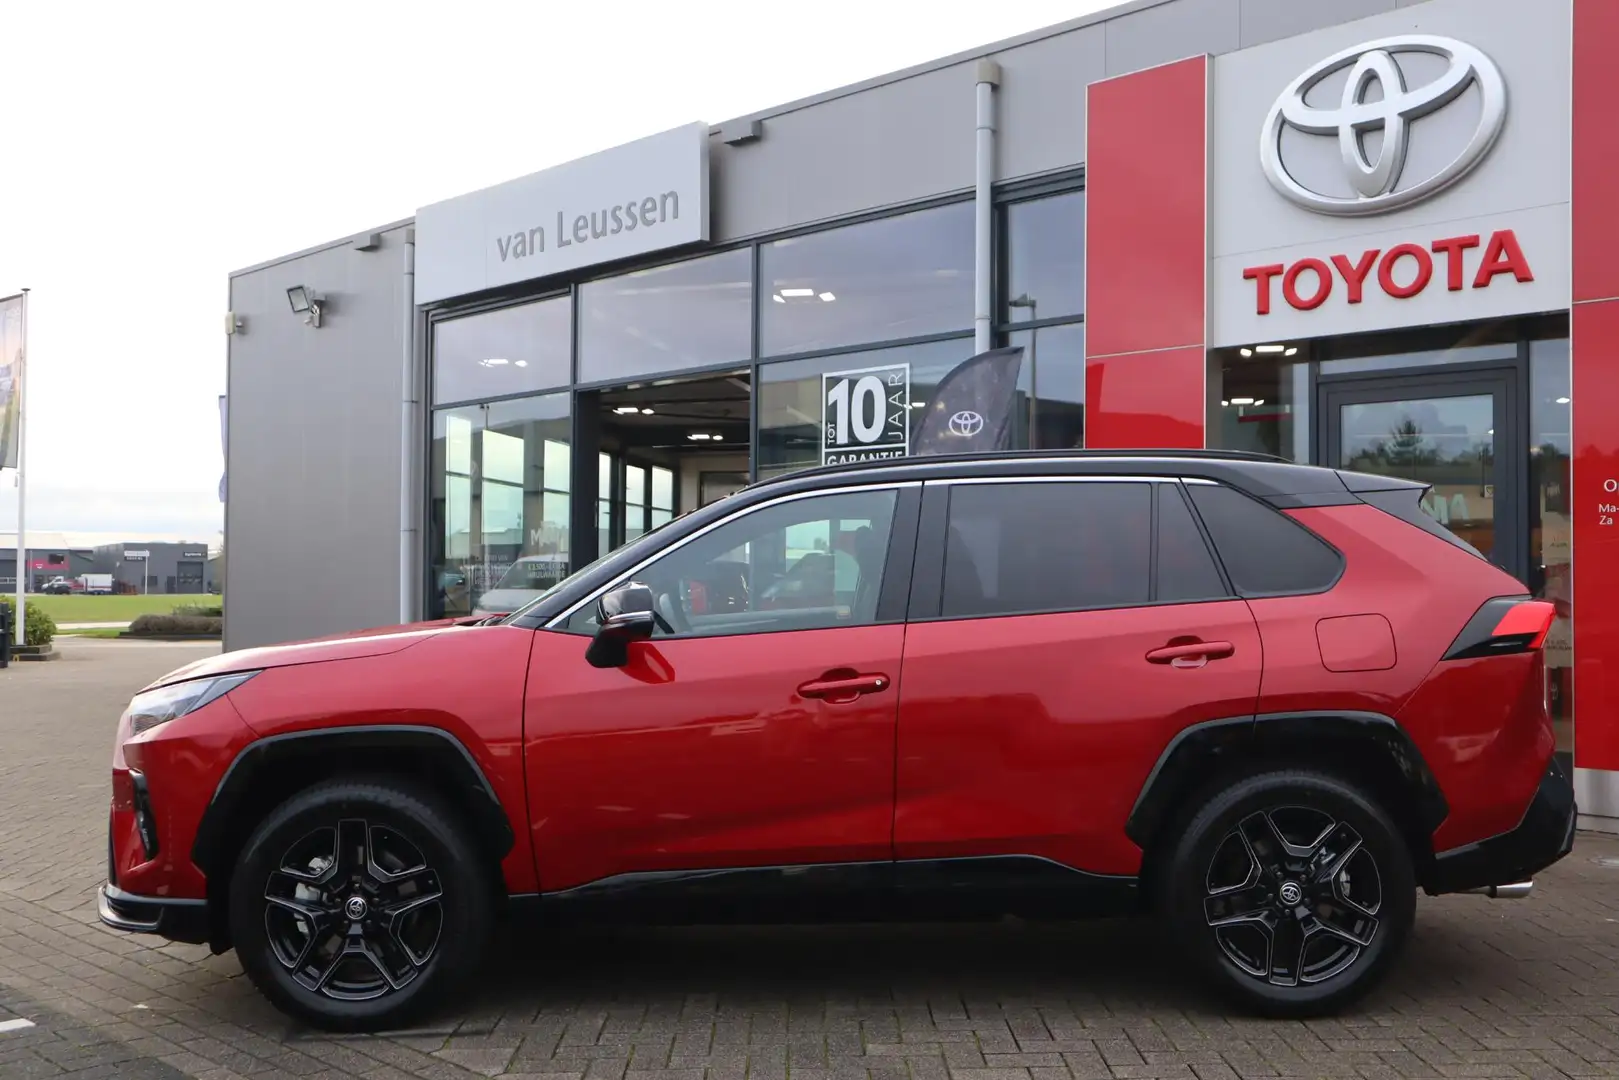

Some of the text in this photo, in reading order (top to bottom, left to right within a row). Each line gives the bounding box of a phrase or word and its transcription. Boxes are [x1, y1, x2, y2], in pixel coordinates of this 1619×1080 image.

[496, 190, 679, 262] van Leussen
[1242, 229, 1534, 315] TOYOTA
[827, 375, 887, 445] 10
[827, 422, 836, 445] TOT
[887, 372, 904, 440] JAAR
[1599, 515, 1613, 525] Za
[1603, 478, 1619, 495] O
